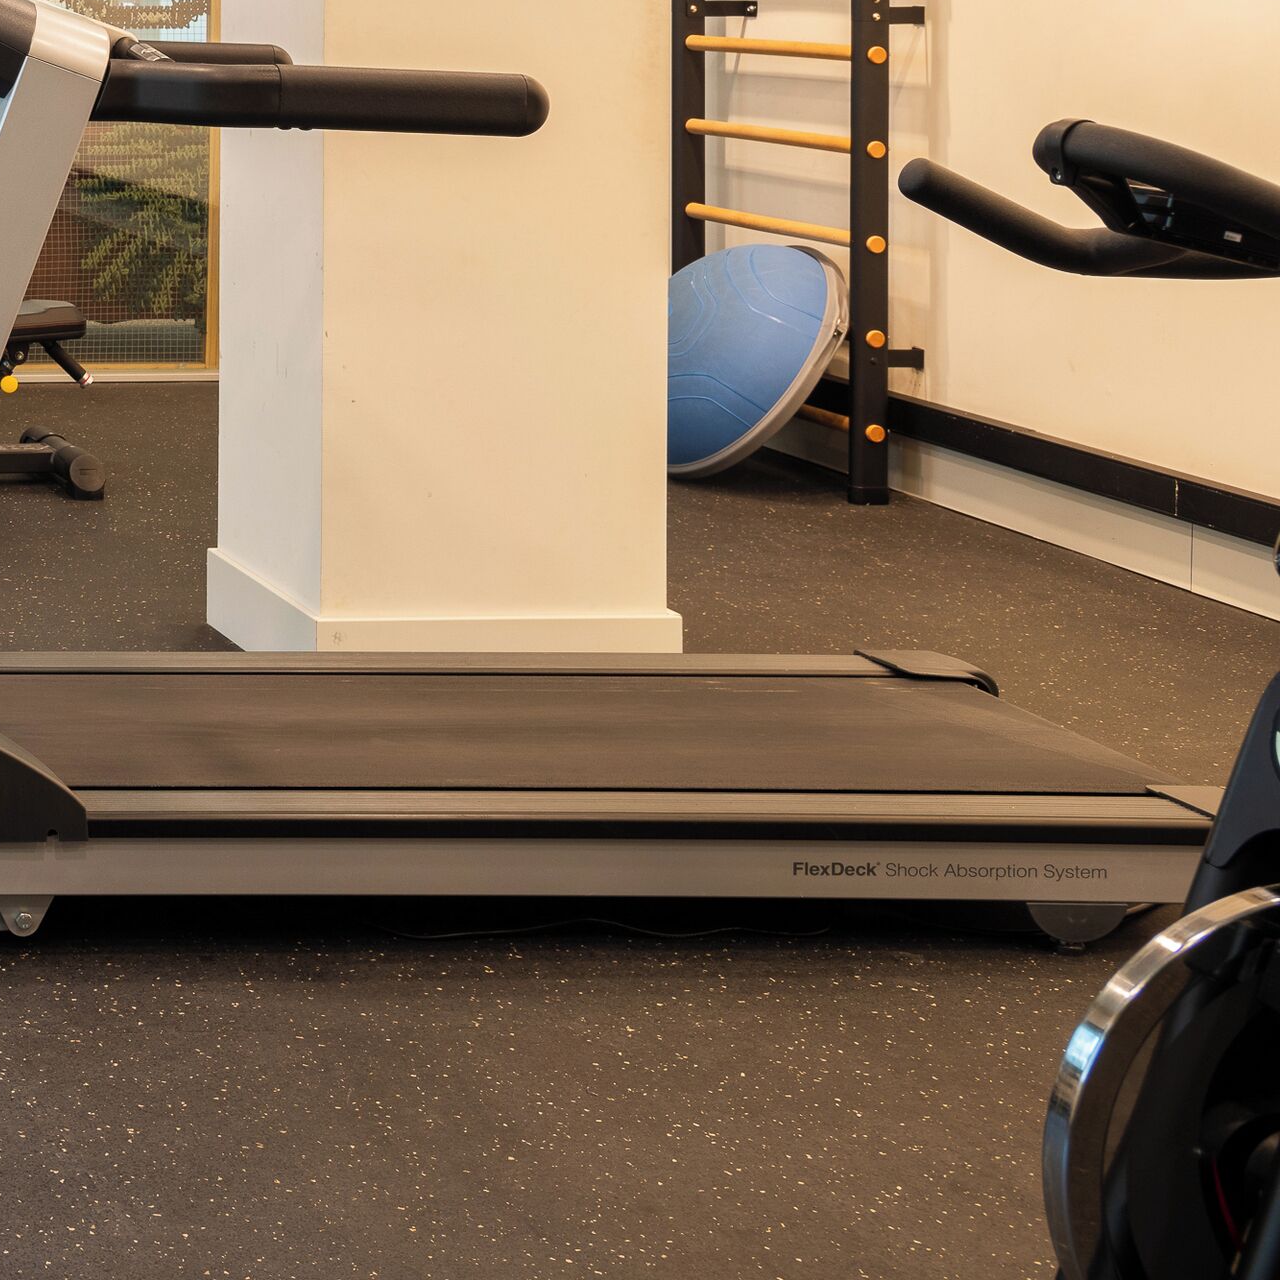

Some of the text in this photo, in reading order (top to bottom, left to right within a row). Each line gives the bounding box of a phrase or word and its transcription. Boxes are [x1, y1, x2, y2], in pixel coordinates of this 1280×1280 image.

[885, 862, 939, 878] Shock
[943, 863, 1038, 881] Absorption
[1043, 864, 1109, 880] System
